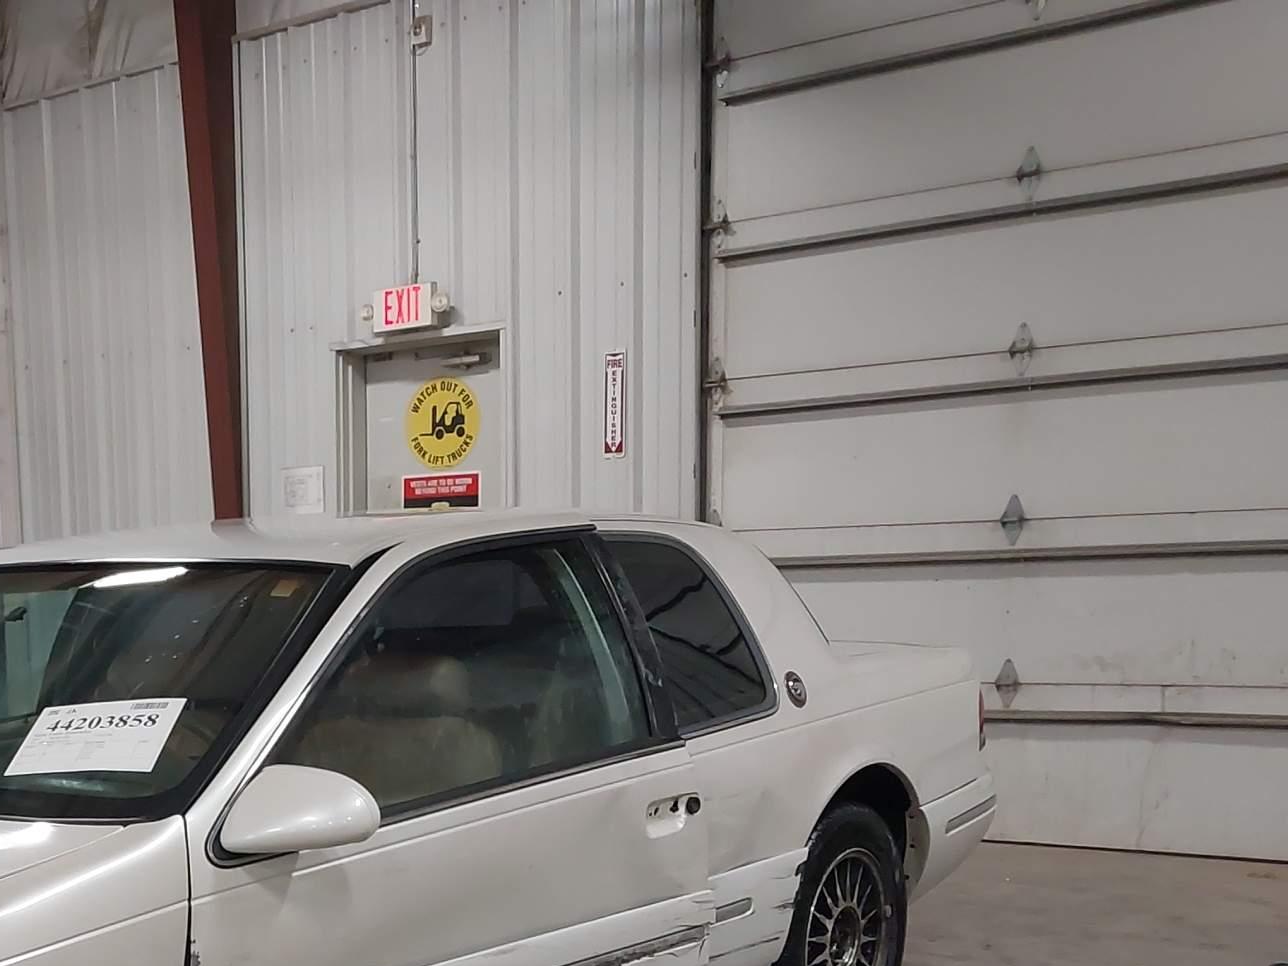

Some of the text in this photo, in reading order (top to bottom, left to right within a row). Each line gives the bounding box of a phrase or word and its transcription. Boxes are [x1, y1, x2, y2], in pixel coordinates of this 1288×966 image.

[384, 286, 421, 325] EXIT
[607, 358, 623, 369] FIRE
[411, 380, 474, 414] WATCH OUT FOR
[411, 433, 474, 465] FORK LIFT TRUCKS
[46, 713, 160, 732] 44203858
